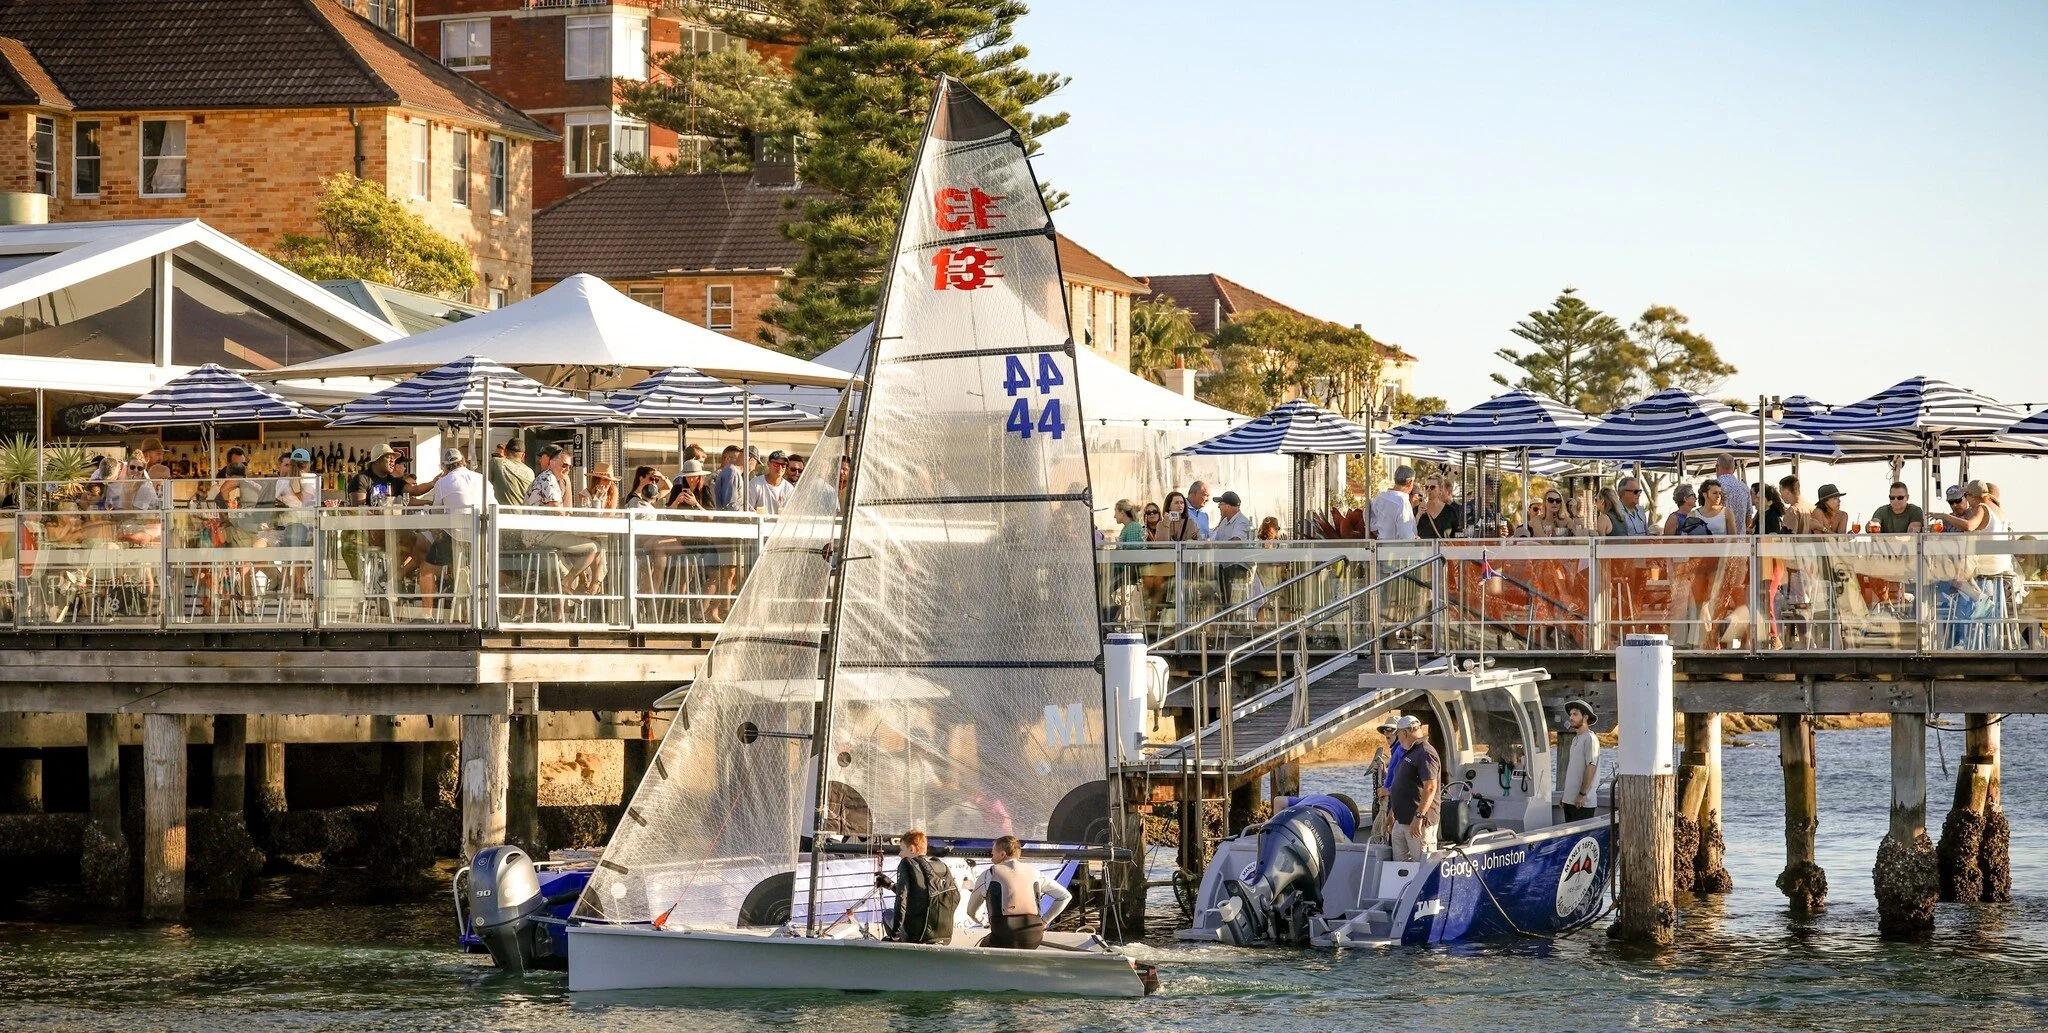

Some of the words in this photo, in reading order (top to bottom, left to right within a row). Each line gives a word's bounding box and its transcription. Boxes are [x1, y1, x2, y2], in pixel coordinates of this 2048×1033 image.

[931, 246, 1005, 290] 13
[81, 403, 107, 414] GRAB
[1006, 398, 1065, 439] 44
[1044, 703, 1085, 747] M
[1441, 859, 1479, 878] George
[1481, 850, 1526, 871] Johnston
[1565, 845, 1581, 873] MANLY
[476, 889, 492, 898] 90
